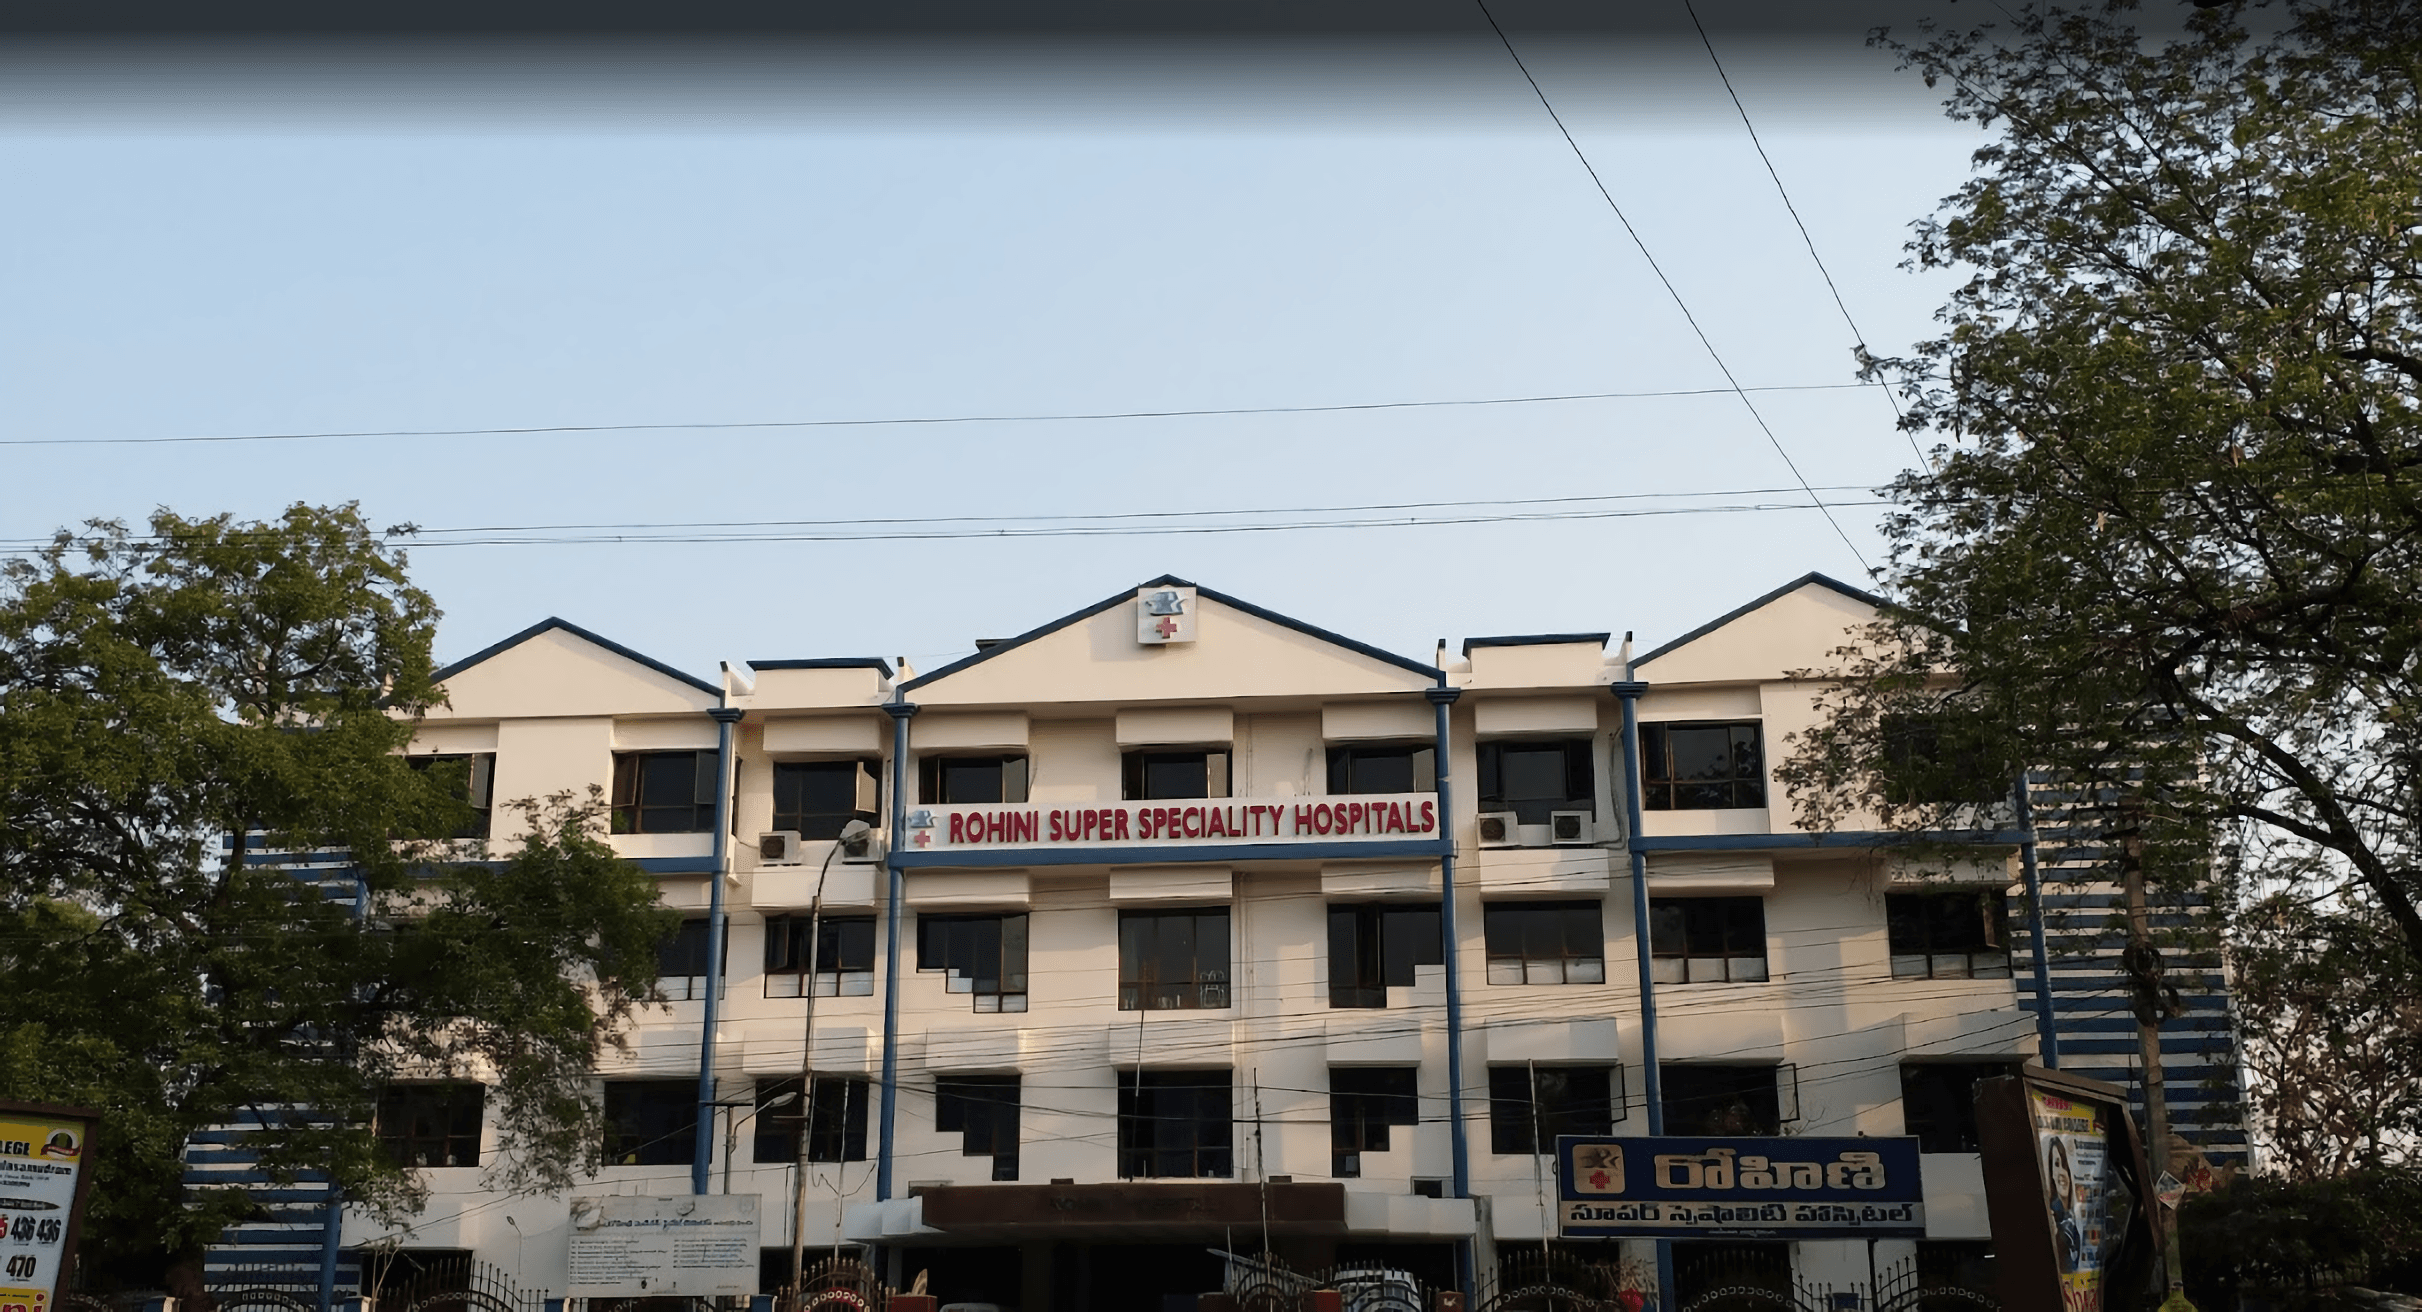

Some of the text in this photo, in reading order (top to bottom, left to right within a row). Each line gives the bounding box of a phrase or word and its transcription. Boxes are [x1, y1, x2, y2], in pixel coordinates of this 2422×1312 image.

[949, 800, 1435, 843] ROHINI SUPER SPECIALITY HOSPITALS
[6, 1255, 36, 1278] 470
